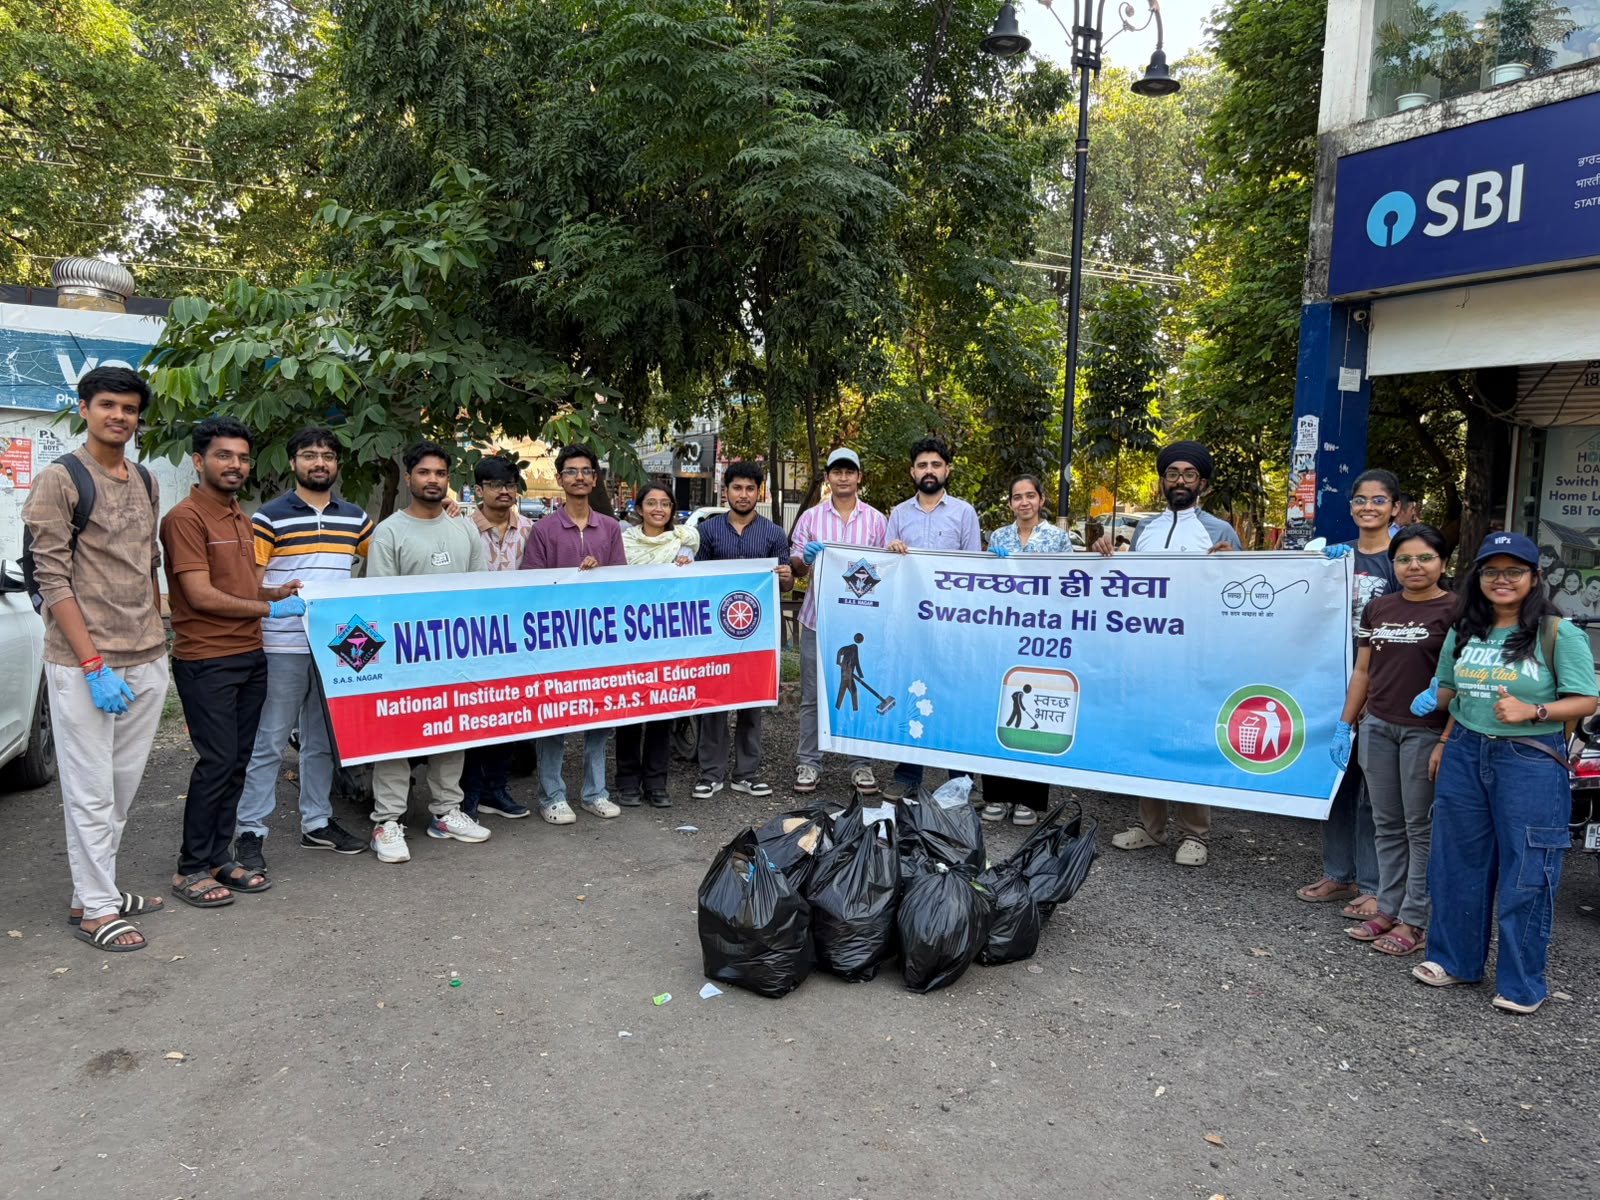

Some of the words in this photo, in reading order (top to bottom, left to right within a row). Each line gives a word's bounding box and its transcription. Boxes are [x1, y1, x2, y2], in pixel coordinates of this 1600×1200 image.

[1422, 163, 1525, 237] SBI
[1555, 475, 1598, 487] Switch
[1549, 490, 1588, 501] Home
[1562, 504, 1582, 516] SBI
[934, 570, 1051, 596] स्वच्छता
[1058, 568, 1093, 598] ही
[1100, 569, 1170, 599] सेवा
[917, 599, 1062, 630] Swachhata
[1071, 609, 1097, 632] Hi
[1105, 609, 1185, 636] Sewa
[393, 613, 518, 665] NATIONAL
[523, 606, 618, 652] SERVICE
[624, 599, 713, 642] SCHEME
[1018, 636, 1073, 659] 2026
[333, 676, 355, 685] S.A.S.
[356, 673, 383, 682] NAGAR
[1491, 667, 1518, 681] Club
[376, 691, 448, 718] National
[453, 684, 520, 708] Institute
[525, 680, 540, 698] of
[544, 668, 659, 696] Pharmaceutical
[663, 661, 731, 683] Education
[422, 715, 453, 737] and
[459, 705, 532, 732] Research
[537, 698, 599, 724] (NIPER),
[603, 691, 645, 712] S.A.S.
[649, 685, 697, 705] NAGAR
[1034, 694, 1071, 709] स्वच्छ
[1034, 708, 1067, 723] भारत
